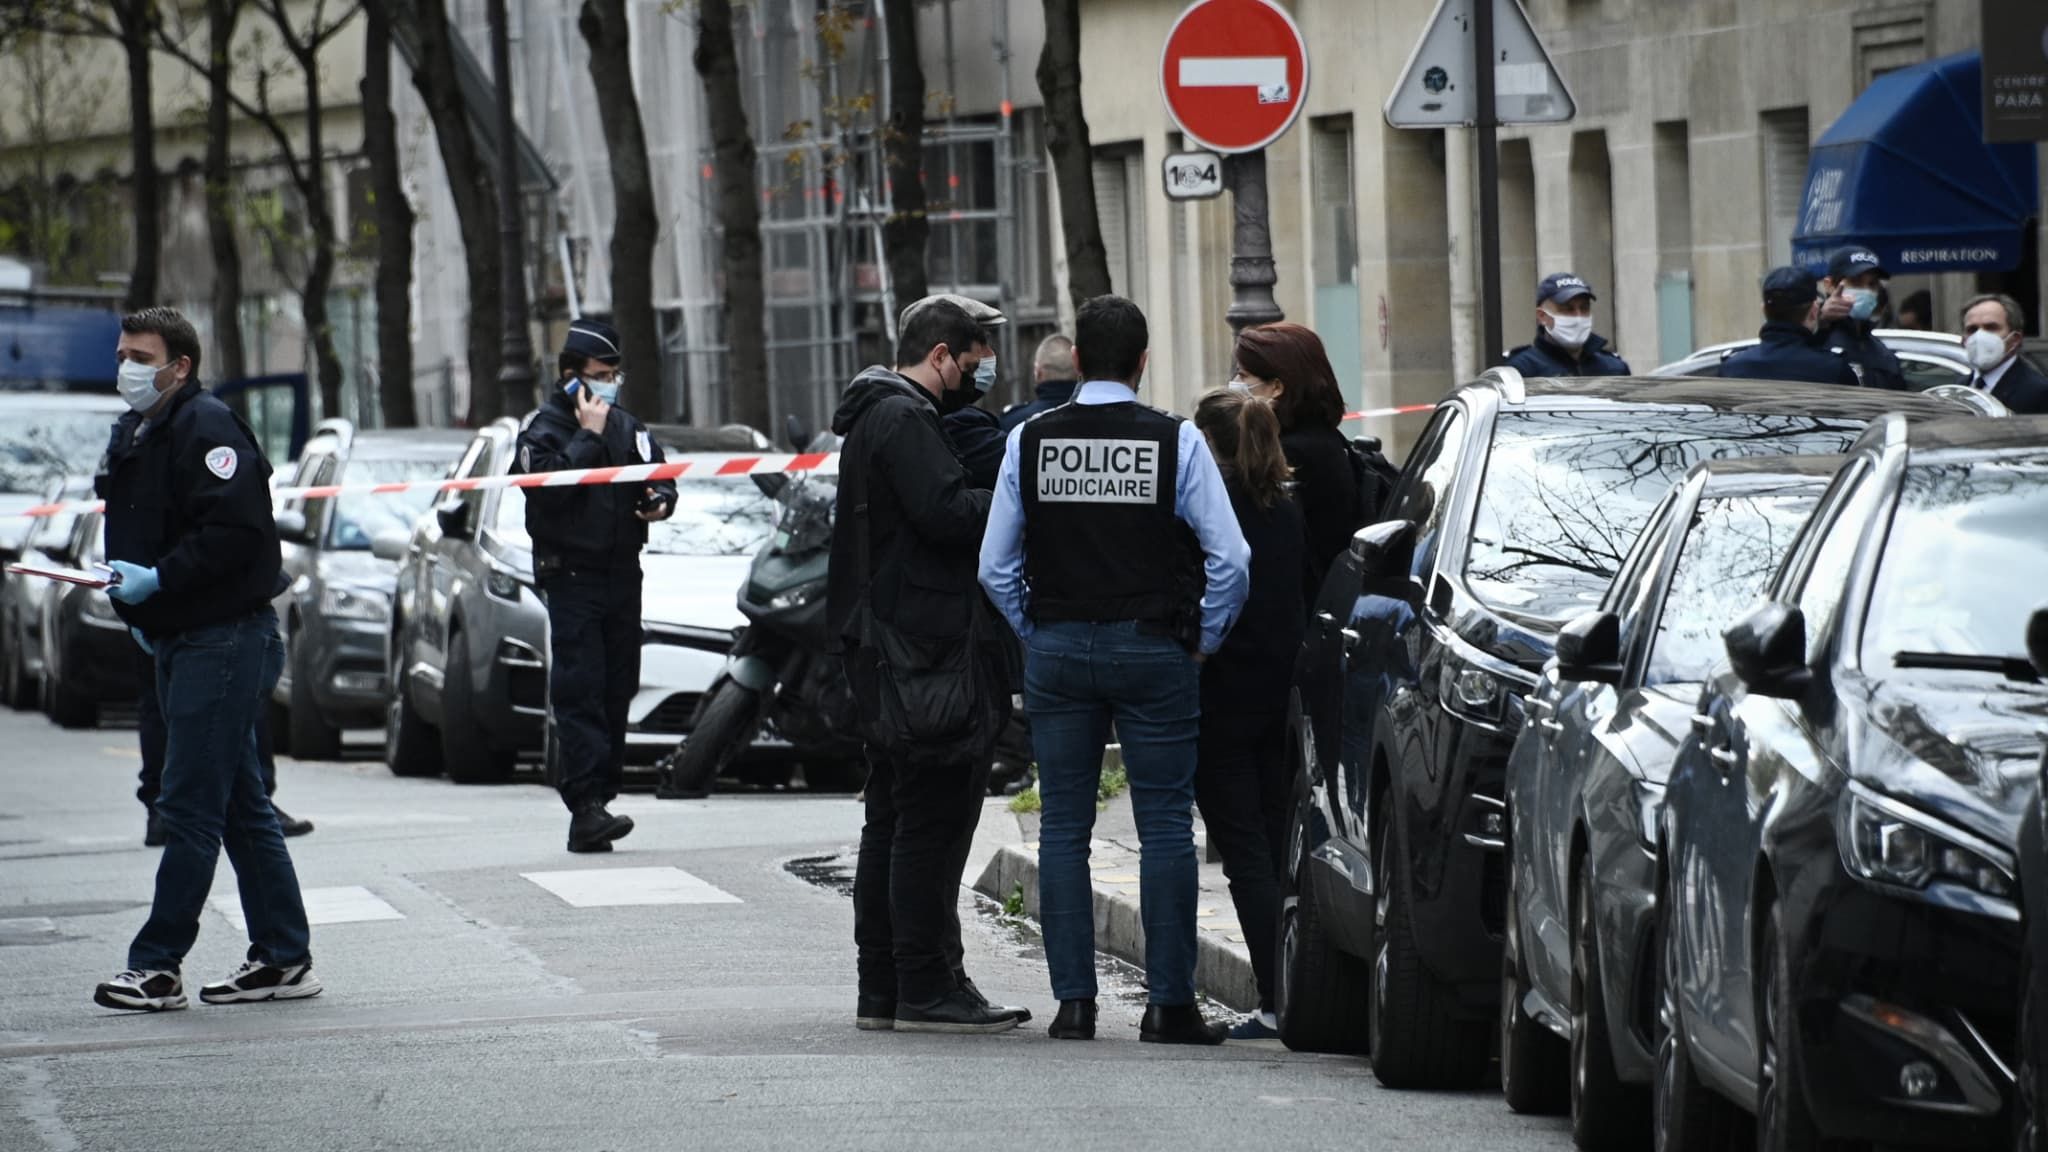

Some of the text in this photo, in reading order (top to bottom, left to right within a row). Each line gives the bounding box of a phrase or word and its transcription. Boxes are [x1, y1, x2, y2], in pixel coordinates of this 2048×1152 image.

[1901, 249, 1997, 264] RESPIRATION
[1041, 445, 1153, 474] POLICE
[1041, 478, 1151, 497] JUDICIAIRE
